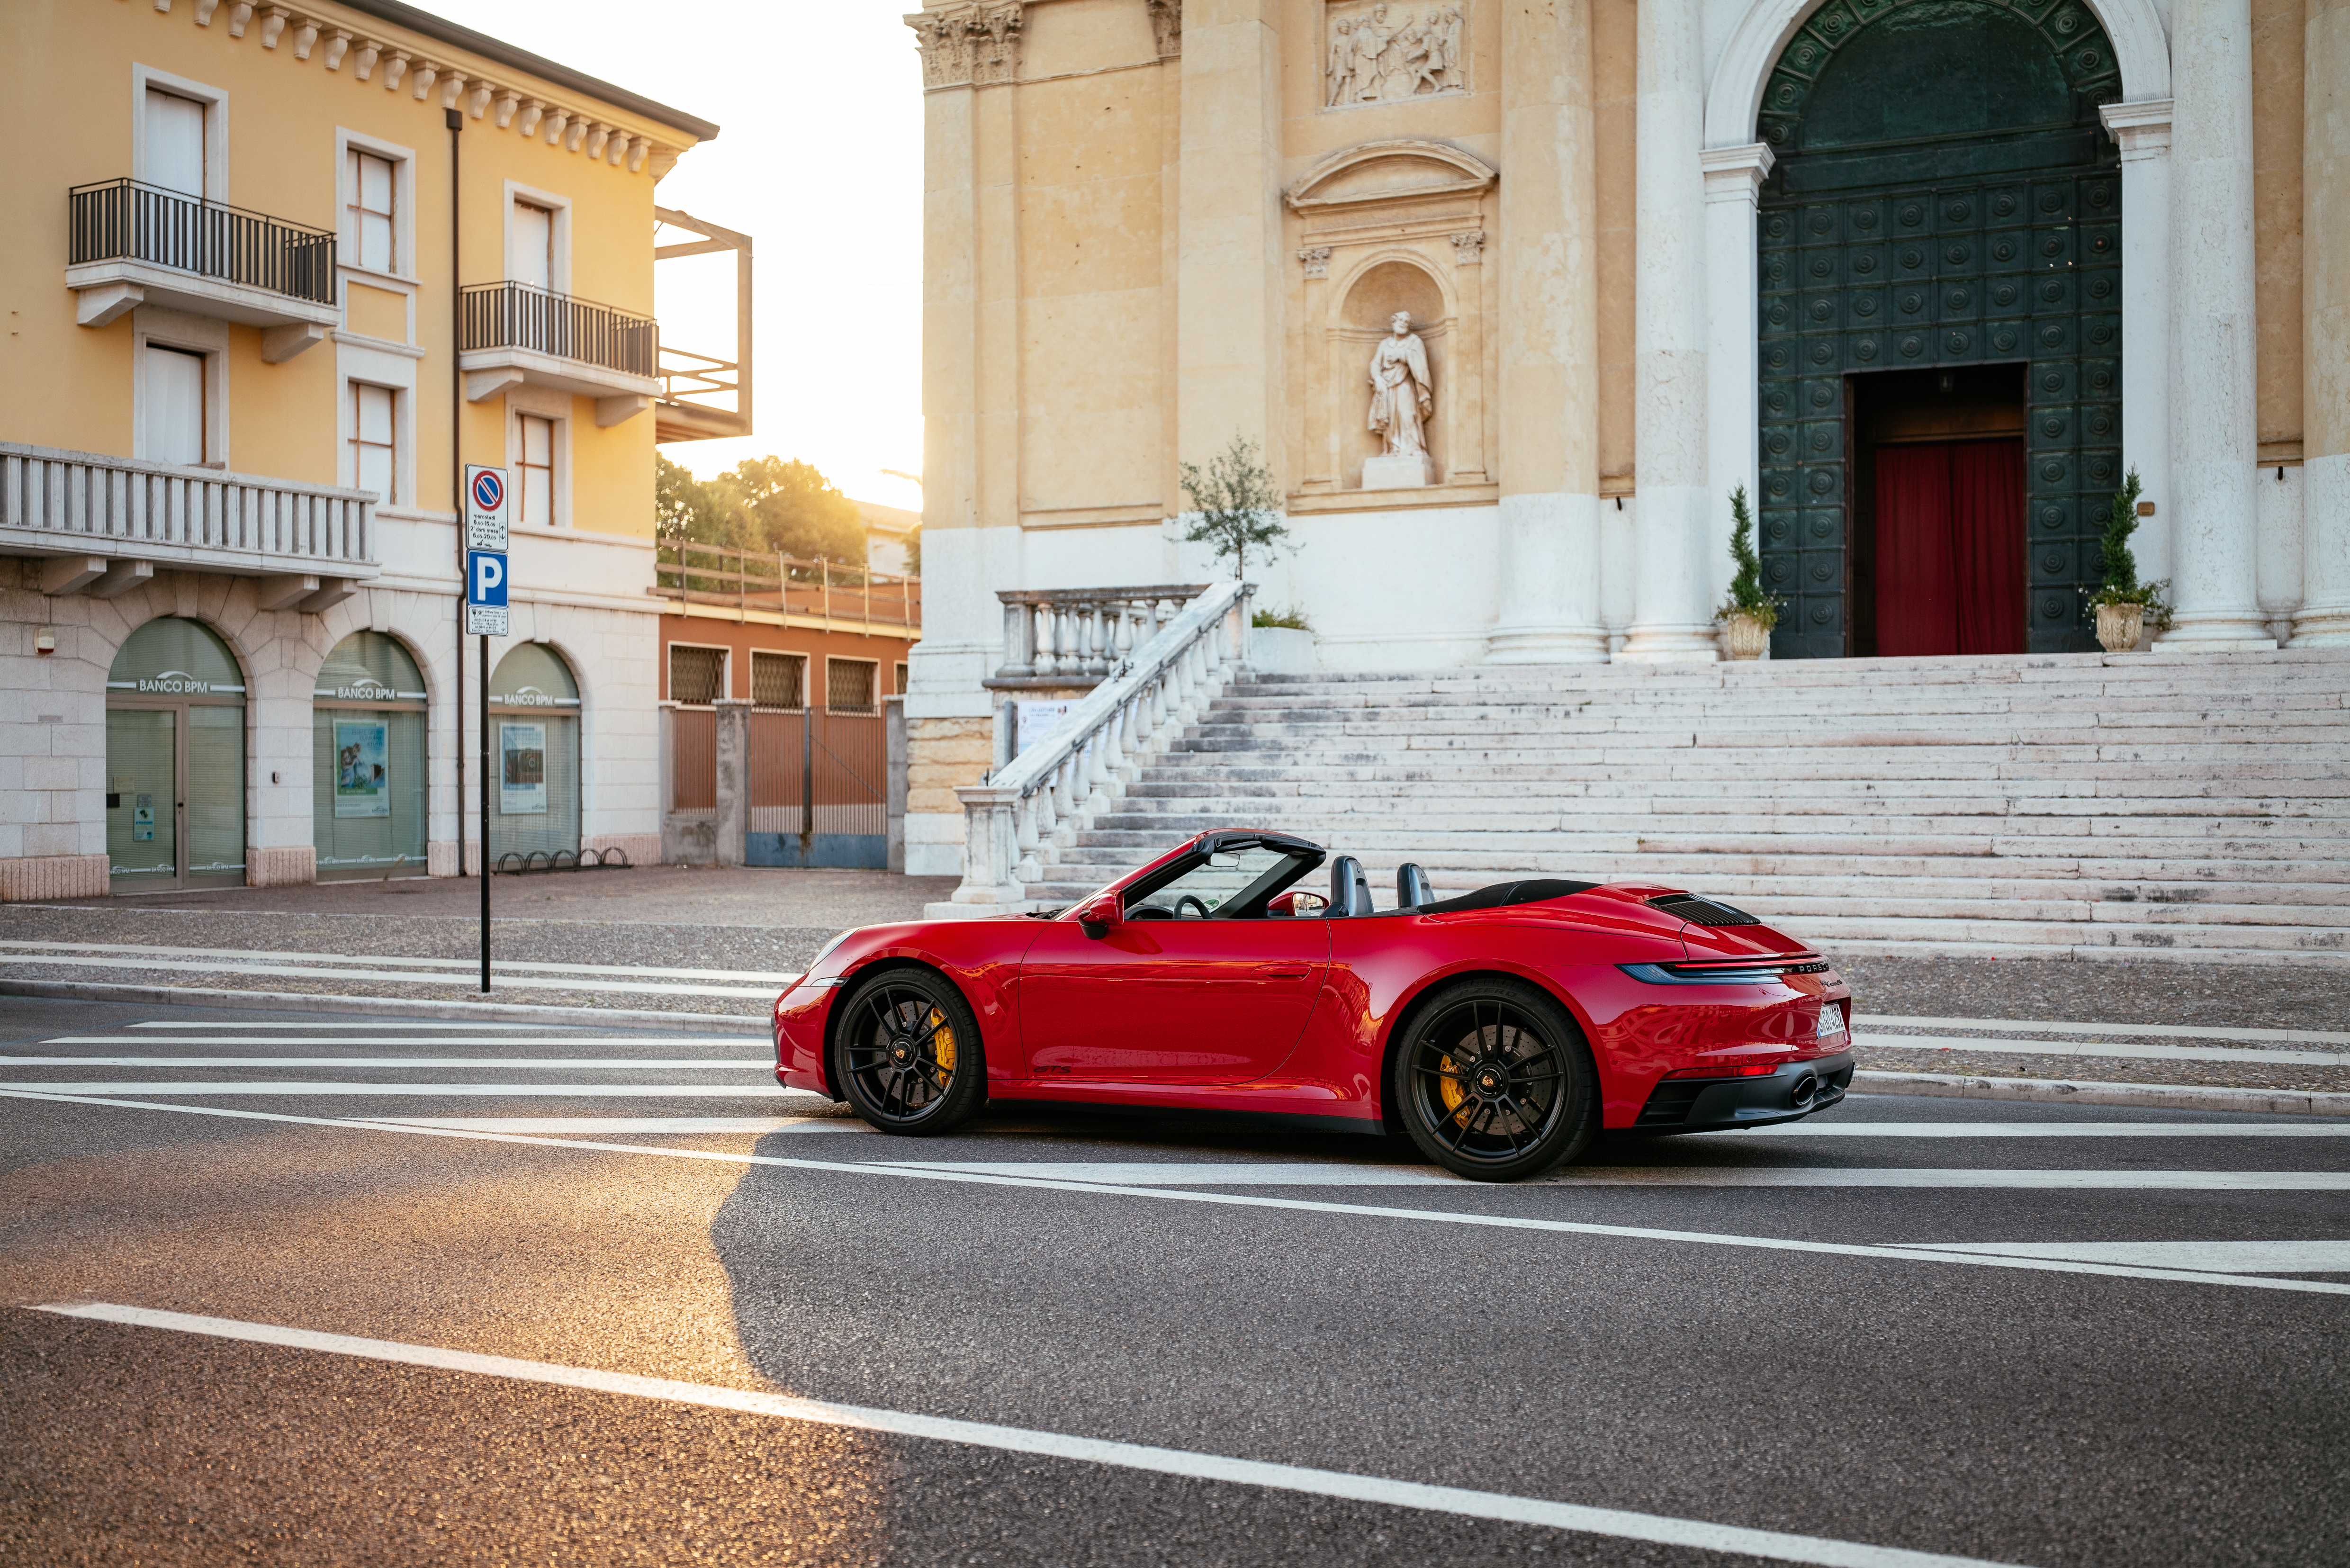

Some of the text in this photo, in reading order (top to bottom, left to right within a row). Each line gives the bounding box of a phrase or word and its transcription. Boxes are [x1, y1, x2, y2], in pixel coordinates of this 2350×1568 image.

[477, 557, 503, 601] P
[140, 679, 207, 694] BANCO BPM
[338, 687, 395, 700] BANCO BPM
[504, 694, 552, 706] BANCO BPM
[1799, 963, 1829, 973] PORSCH
[1471, 987, 1518, 998] ZERO
